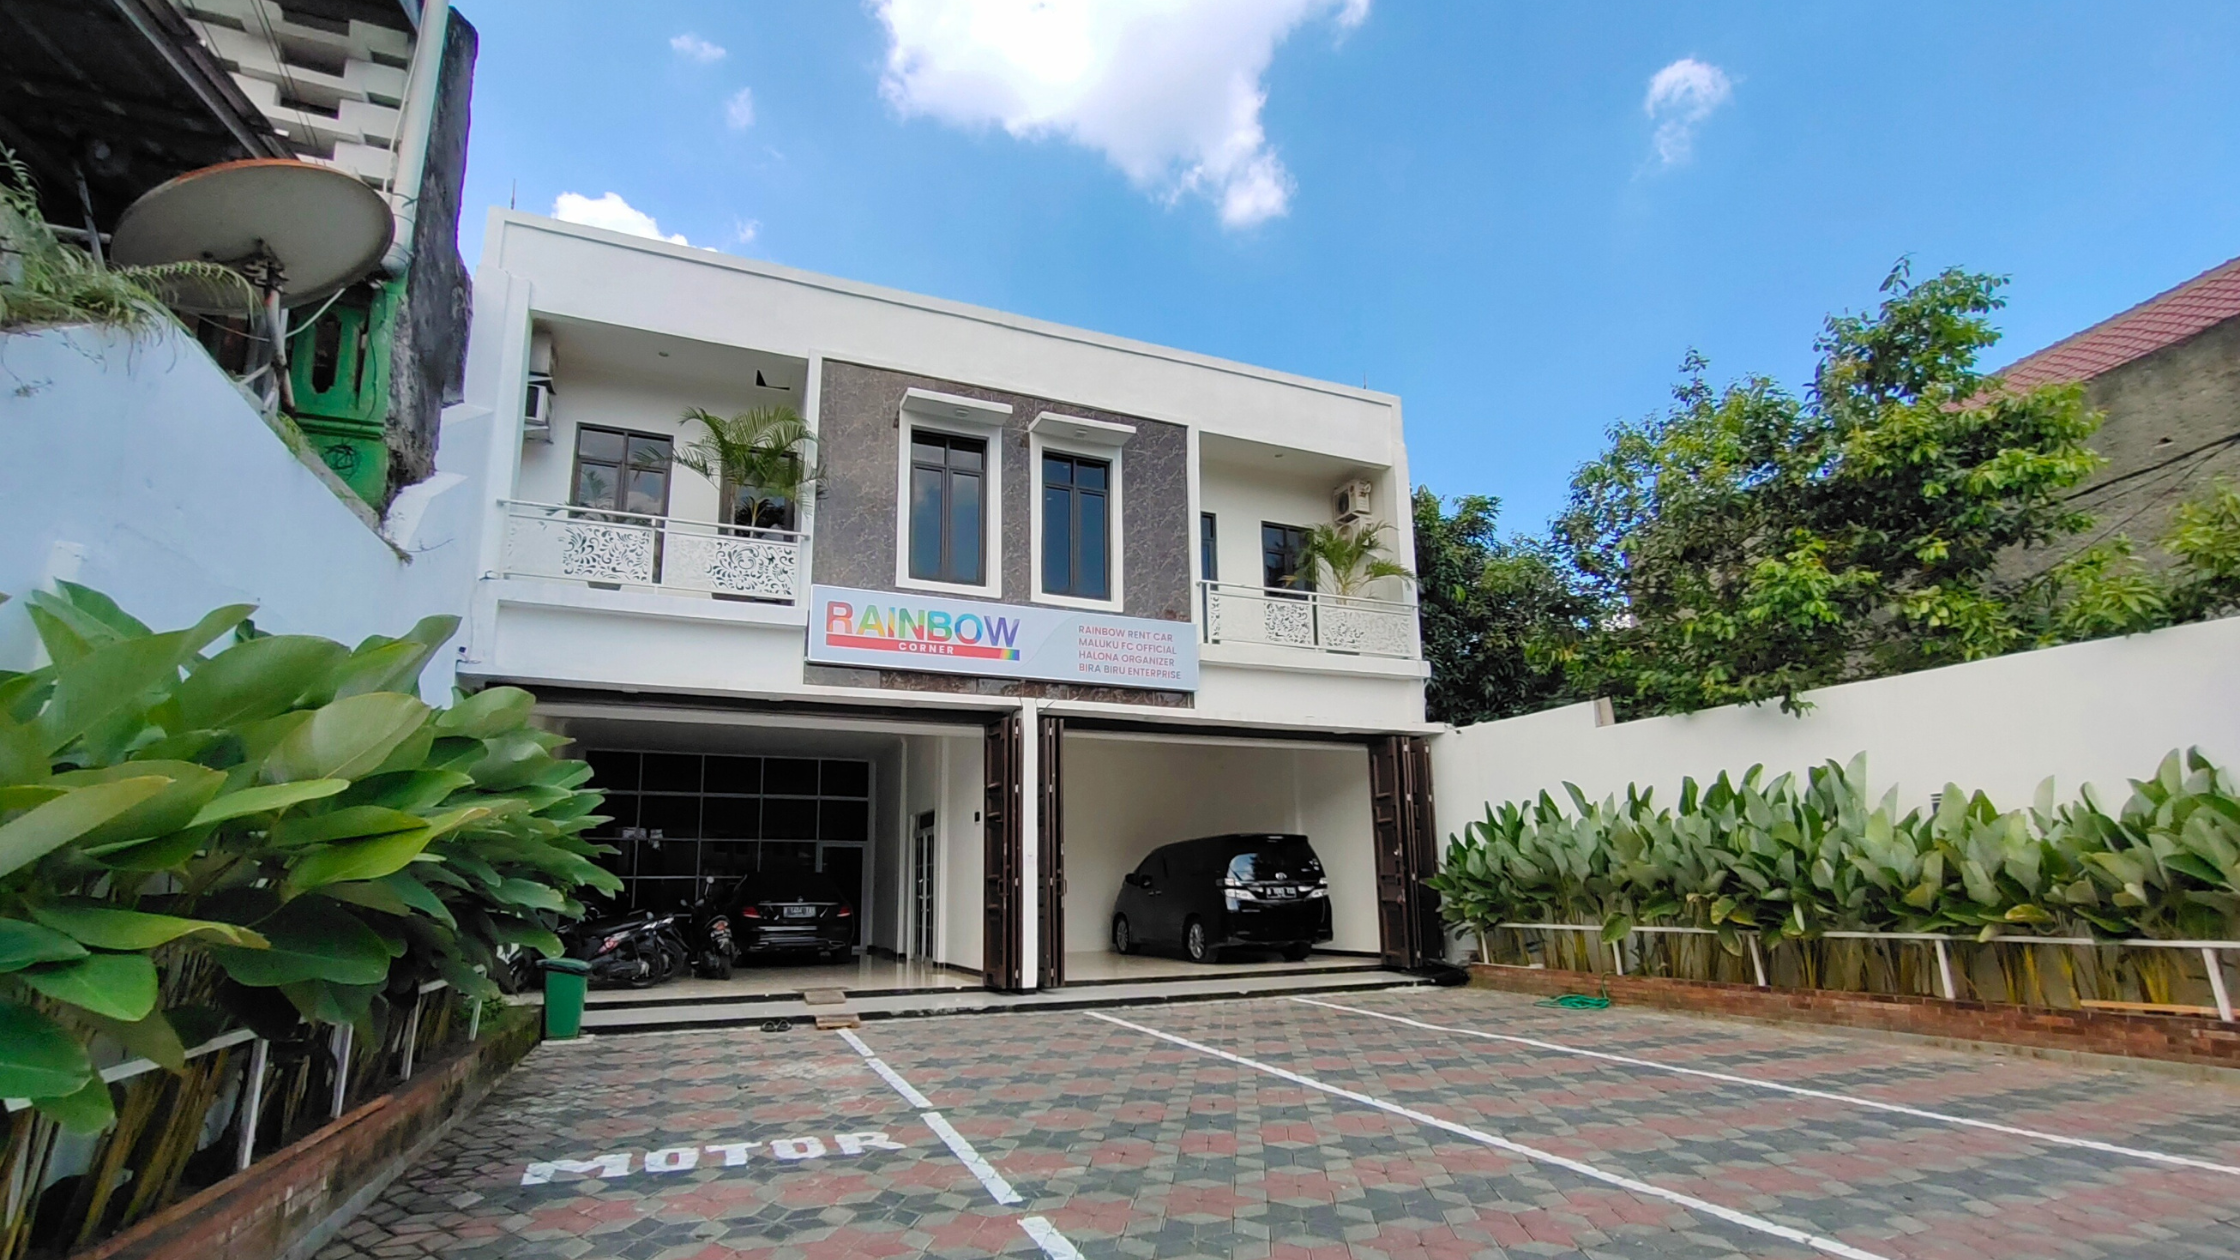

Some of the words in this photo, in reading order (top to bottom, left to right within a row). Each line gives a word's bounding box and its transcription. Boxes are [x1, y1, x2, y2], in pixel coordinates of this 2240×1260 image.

[826, 601, 1020, 647] RAINBOW
[1078, 625, 1125, 638] RAINBOW
[1127, 630, 1151, 640] RENT
[1153, 633, 1173, 642] CAR
[898, 642, 954, 655] CORNER
[1078, 638, 1119, 649] MALUKU
[1121, 642, 1133, 651] FC
[1135, 643, 1177, 654] OFFICIAL
[1078, 650, 1119, 662] HALONA
[1121, 654, 1175, 666] ORGANIZER
[1078, 663, 1101, 673] BIRA
[1103, 665, 1125, 675] BIRU
[1127, 667, 1181, 679] ENTERPRISE
[520, 1132, 907, 1186] MOTOR
